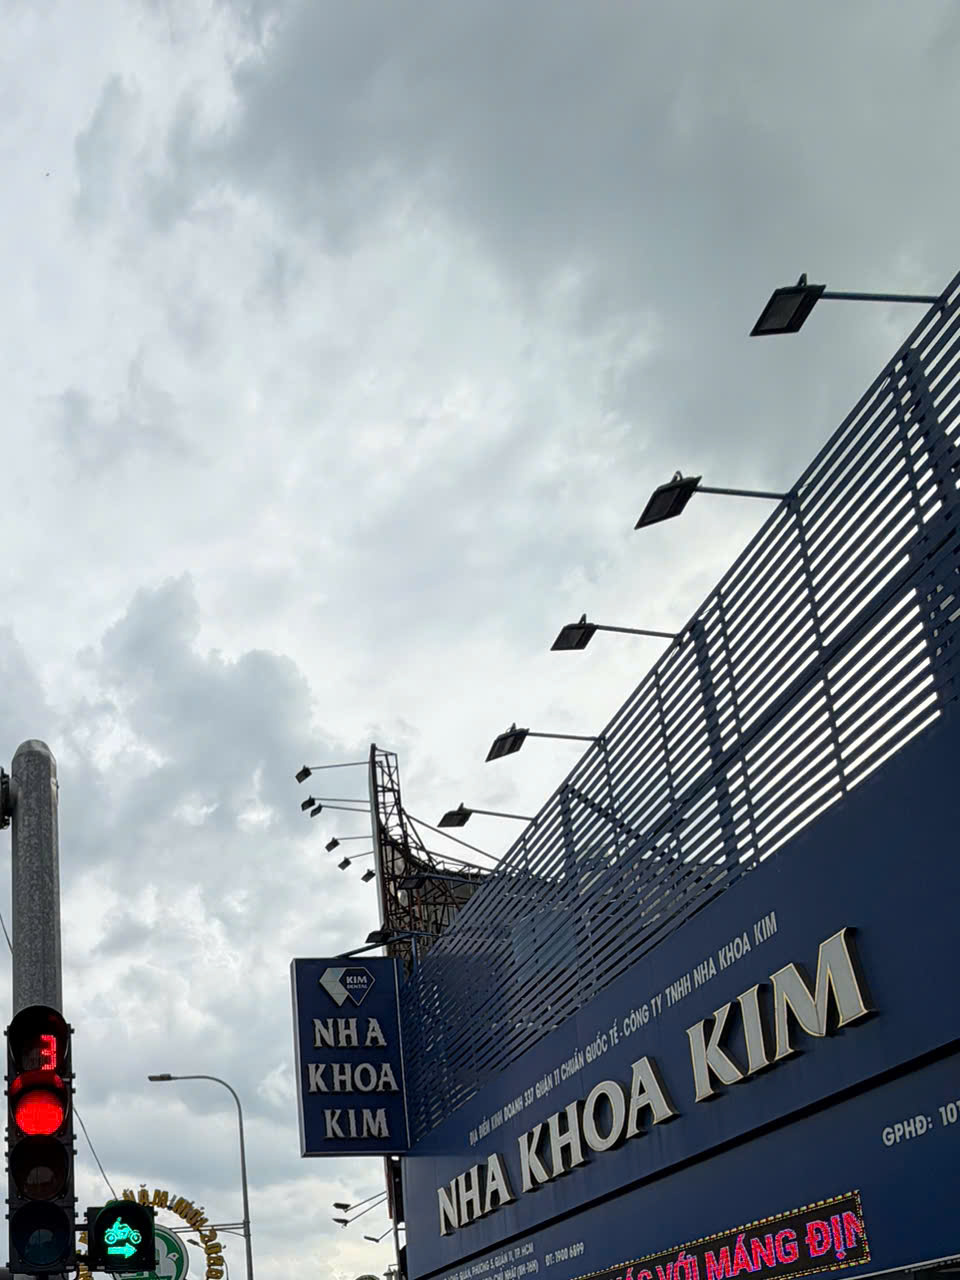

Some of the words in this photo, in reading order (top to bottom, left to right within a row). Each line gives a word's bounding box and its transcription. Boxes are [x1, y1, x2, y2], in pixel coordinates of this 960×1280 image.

[346, 975, 368, 984] KIM
[585, 1032, 608, 1062] QUỐC
[609, 1018, 619, 1046] TẾ
[623, 1004, 650, 1037] CÔNG
[650, 993, 663, 1018] TY
[665, 973, 691, 1008] TNHH
[693, 957, 717, 989] NHA
[718, 932, 752, 970] KHOA
[753, 911, 778, 946] KIM
[313, 1017, 387, 1048] NHA
[41, 1034, 57, 1070] 3
[307, 1063, 399, 1093] KHOA
[438, 1153, 513, 1236] NHA
[518, 1056, 677, 1193] KHOA
[686, 927, 870, 1102] KIM
[324, 1108, 390, 1138] KIM
[882, 1115, 933, 1146] GPHĐ:
